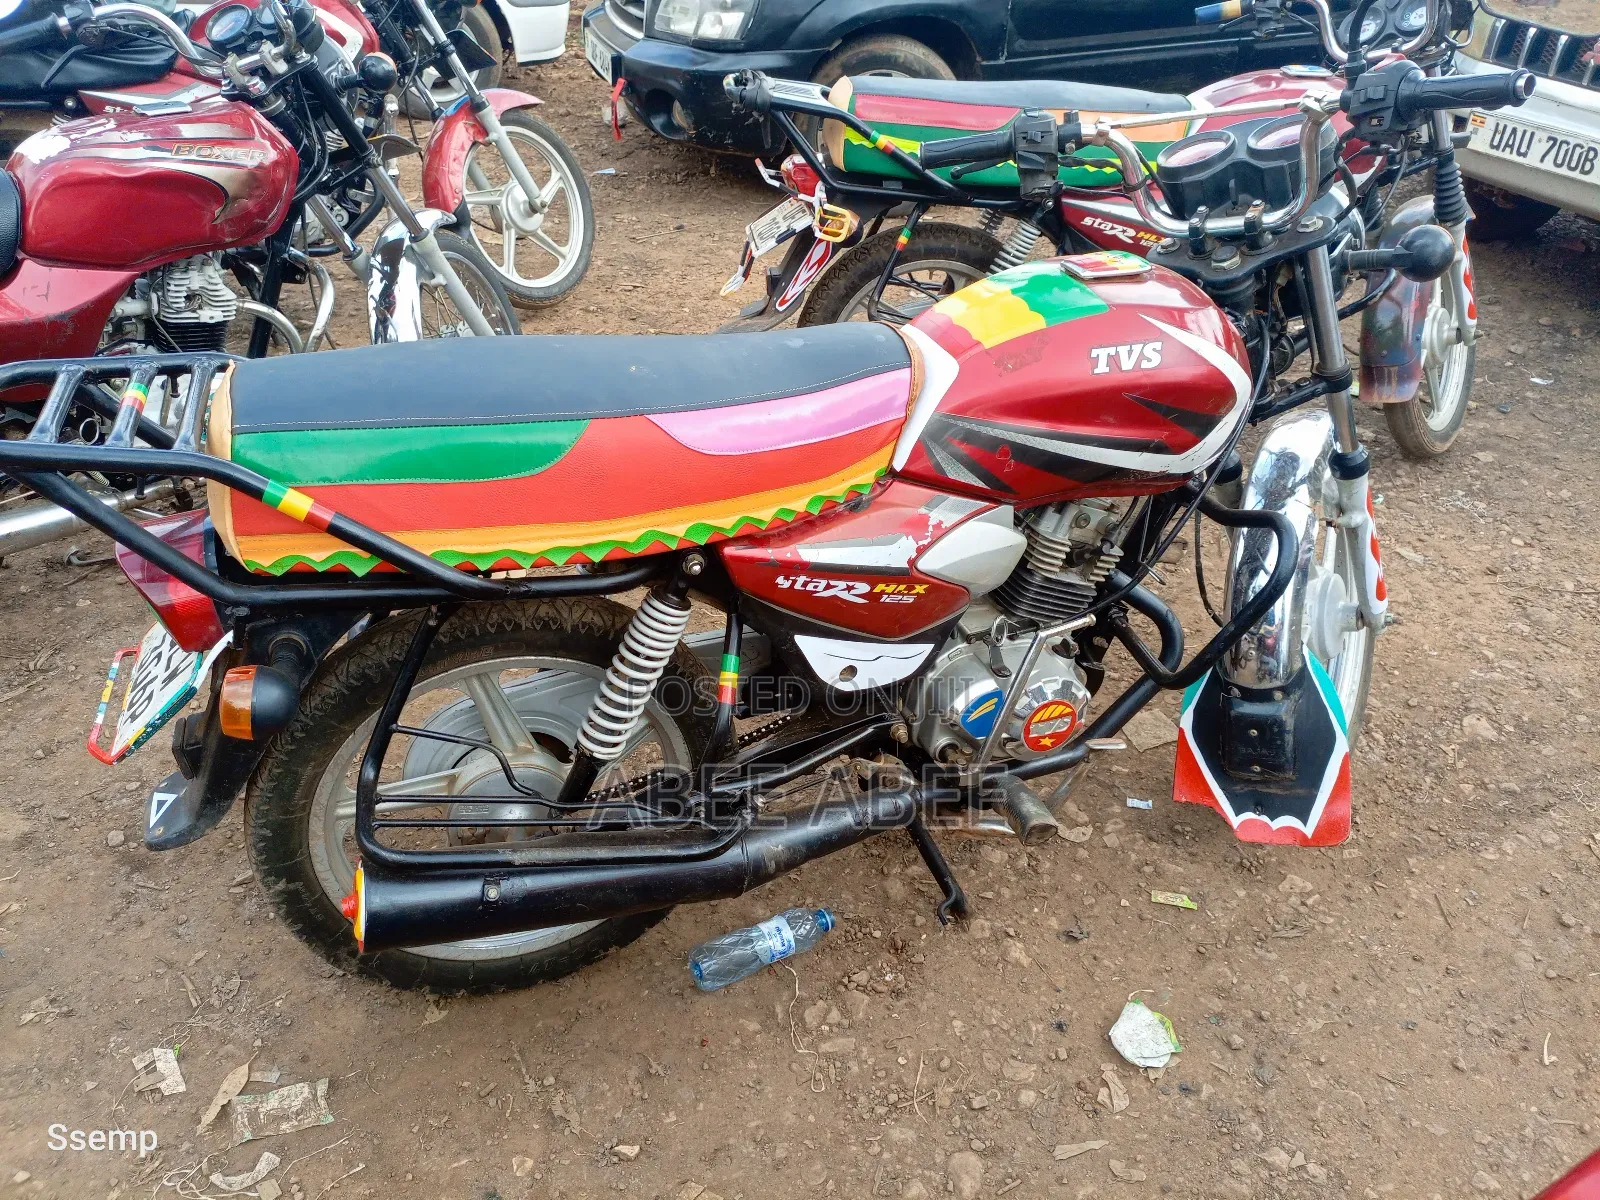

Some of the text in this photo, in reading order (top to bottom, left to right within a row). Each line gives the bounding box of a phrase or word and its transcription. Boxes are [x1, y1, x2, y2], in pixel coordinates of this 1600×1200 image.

[171, 143, 269, 163] BOXER
[1489, 121, 1599, 176] UAU 700B
[1090, 341, 1163, 374] TVS
[879, 594, 918, 604] 125
